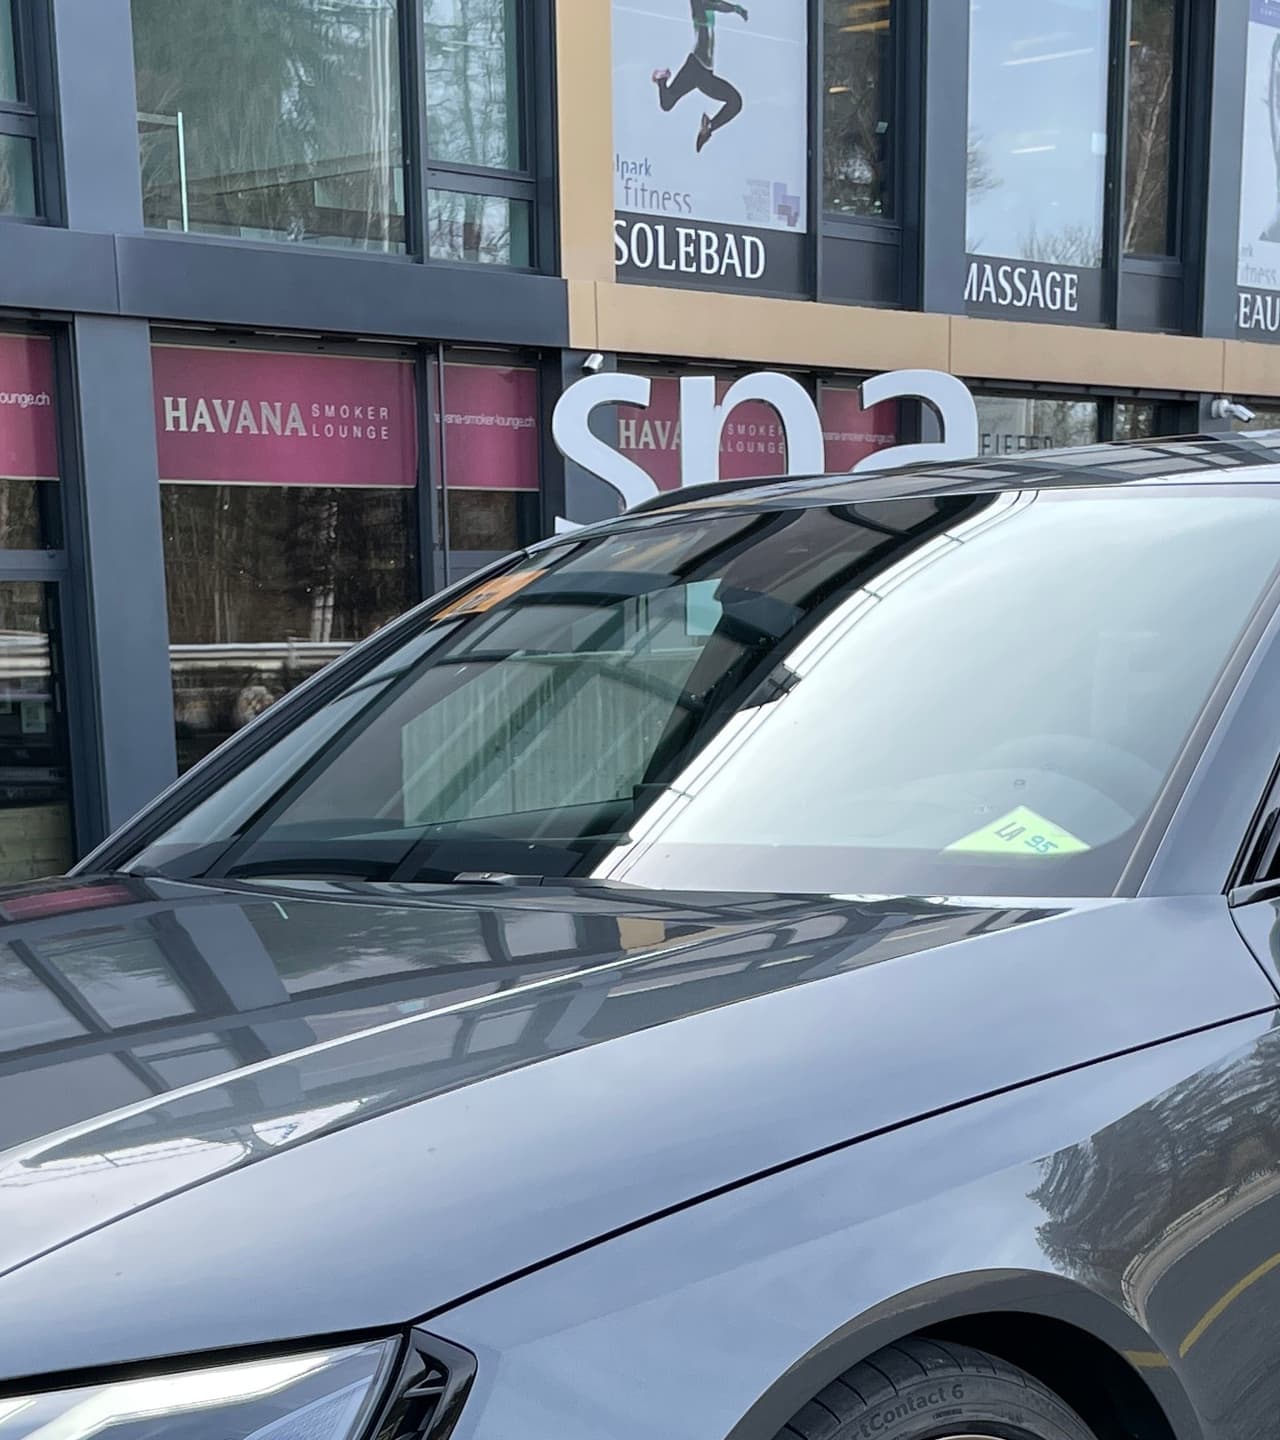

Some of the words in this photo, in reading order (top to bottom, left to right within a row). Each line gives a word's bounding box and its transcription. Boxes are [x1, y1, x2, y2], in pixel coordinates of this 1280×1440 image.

[624, 178, 692, 214] fitness
[614, 220, 766, 279] SOLEBAD
[163, 396, 308, 437] HAVANA
[312, 403, 390, 420] SMOKER
[312, 424, 390, 440] LOUNGE
[951, 1383, 965, 1400] 6
